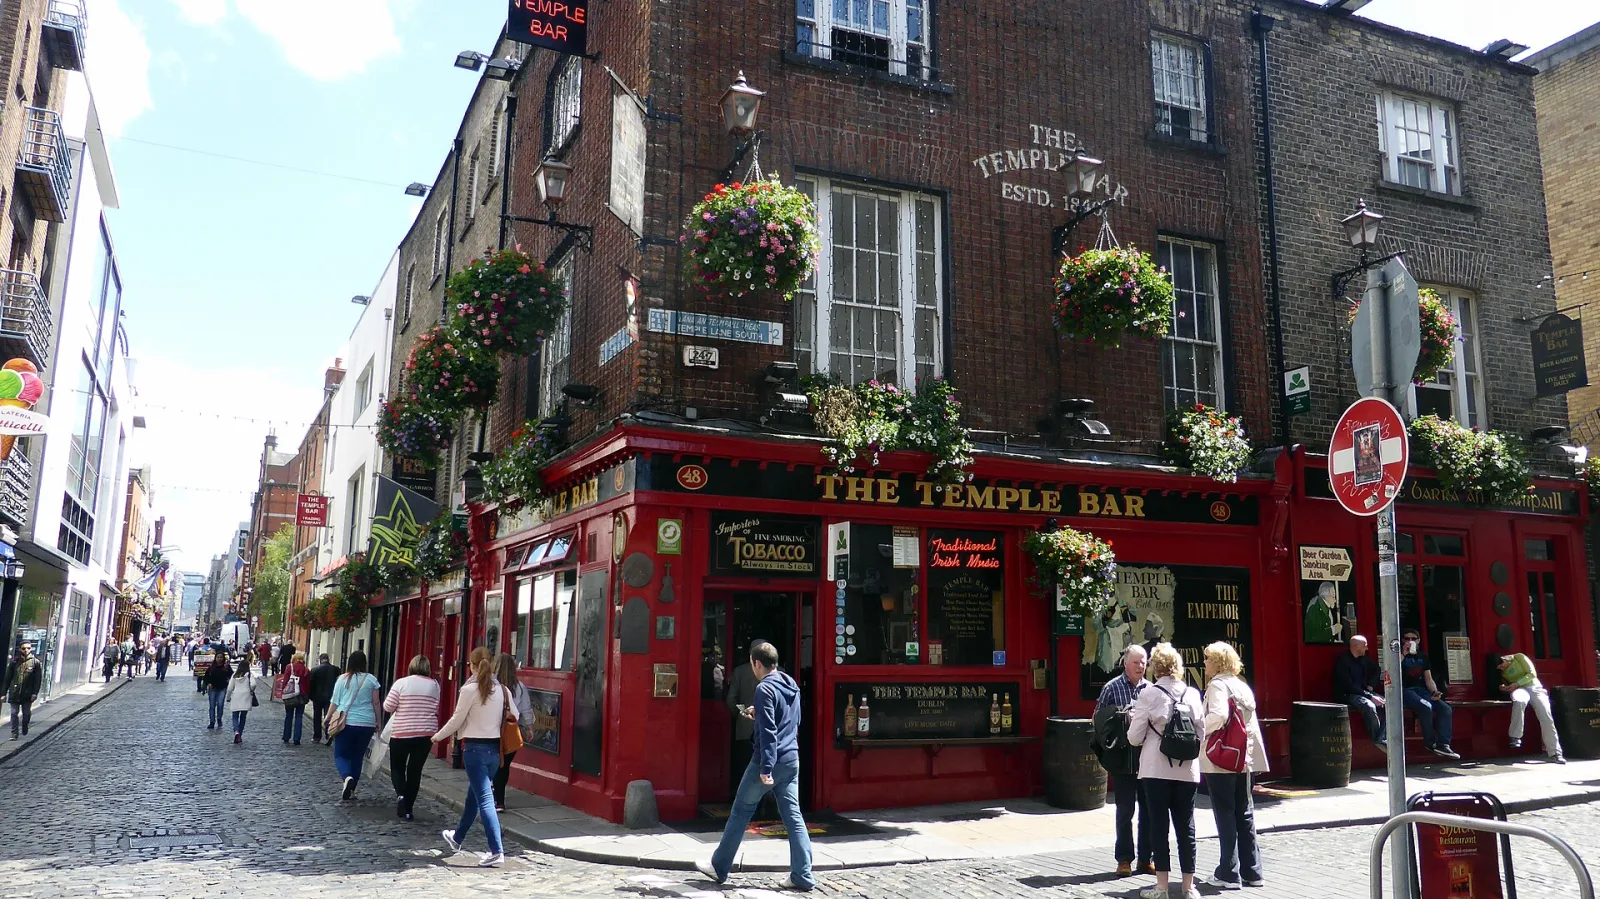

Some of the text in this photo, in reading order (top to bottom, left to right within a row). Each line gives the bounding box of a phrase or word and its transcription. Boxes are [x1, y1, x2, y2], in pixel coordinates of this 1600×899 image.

[514, 0, 585, 23] EMPLE
[531, 19, 568, 41] BAR
[1029, 124, 1076, 151] THE
[1096, 174, 1129, 207] AR
[710, 327, 732, 337] LANE
[735, 331, 763, 340] SOUTH
[773, 328, 779, 340] 2
[1546, 339, 1568, 351] BAR
[683, 470, 702, 483] 48
[572, 477, 598, 508] BAR
[816, 474, 1146, 517] THE TEMPLE BAR
[1214, 503, 1226, 517] 48
[715, 518, 760, 536] Importers
[754, 533, 805, 543] FINE SMOKING
[932, 538, 997, 551] Traditional
[727, 537, 806, 565] TOBACCO
[1302, 549, 1317, 559] Beer
[1318, 550, 1342, 560] Garden
[742, 560, 773, 569] Always
[787, 562, 811, 570] Stock
[930, 553, 1000, 568] Irish Music
[1302, 560, 1329, 571] Smoking
[1115, 571, 1172, 586] TEMPLE
[1308, 570, 1324, 579] Area
[1132, 585, 1160, 600] BAR
[1215, 584, 1239, 601] THE
[1187, 602, 1239, 620] EMPEROR
[1227, 622, 1239, 638] OF
[872, 685, 987, 699] THE TEMPLE BAR
[1439, 836, 1477, 845] Restaurant
